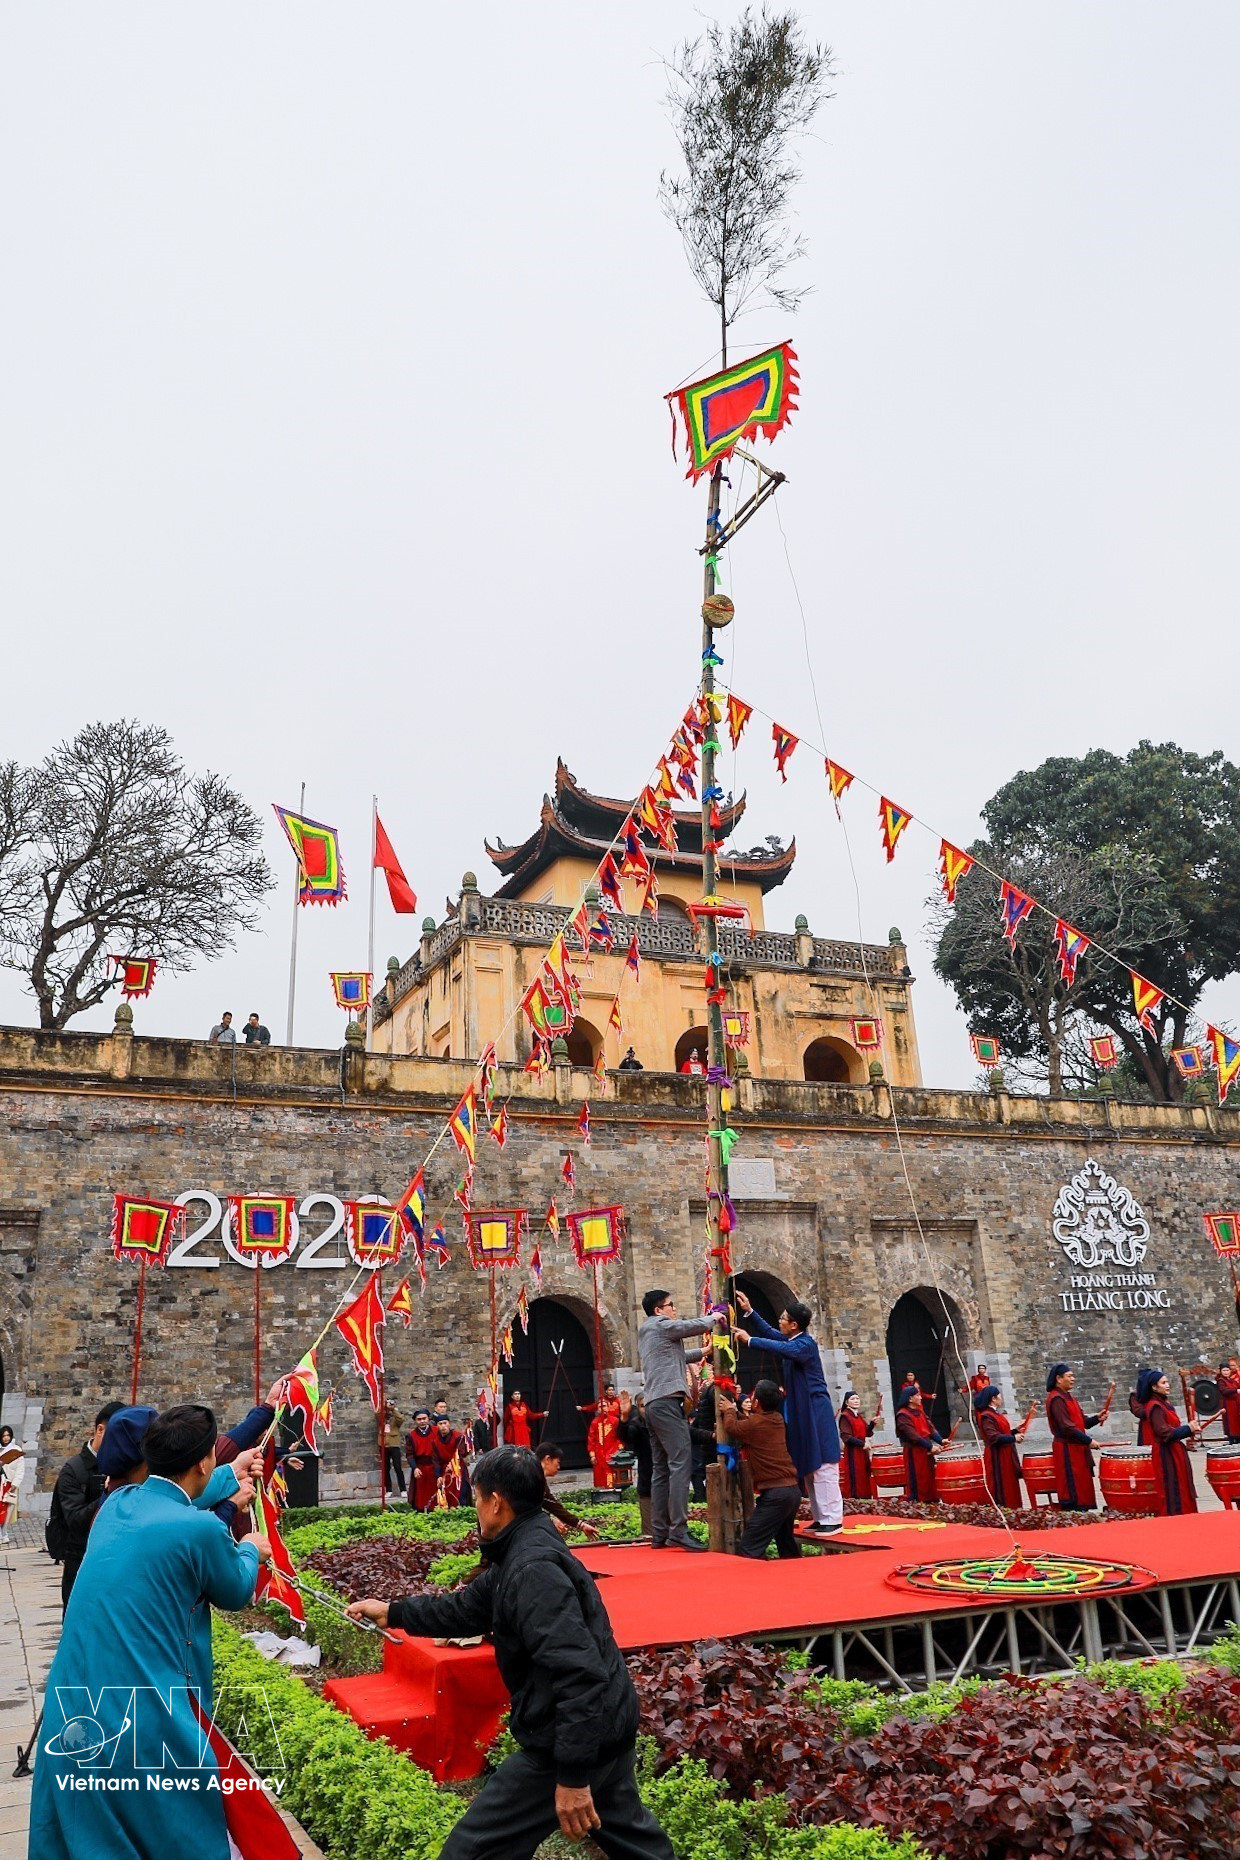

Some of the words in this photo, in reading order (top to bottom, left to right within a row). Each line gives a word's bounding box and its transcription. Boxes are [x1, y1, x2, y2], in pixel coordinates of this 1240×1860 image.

[1070, 1273, 1114, 1288] HOÀNG
[1114, 1271, 1156, 1286] THÀNH
[1058, 1288, 1124, 1311] THĂNG
[1127, 1290, 1171, 1309] LONG
